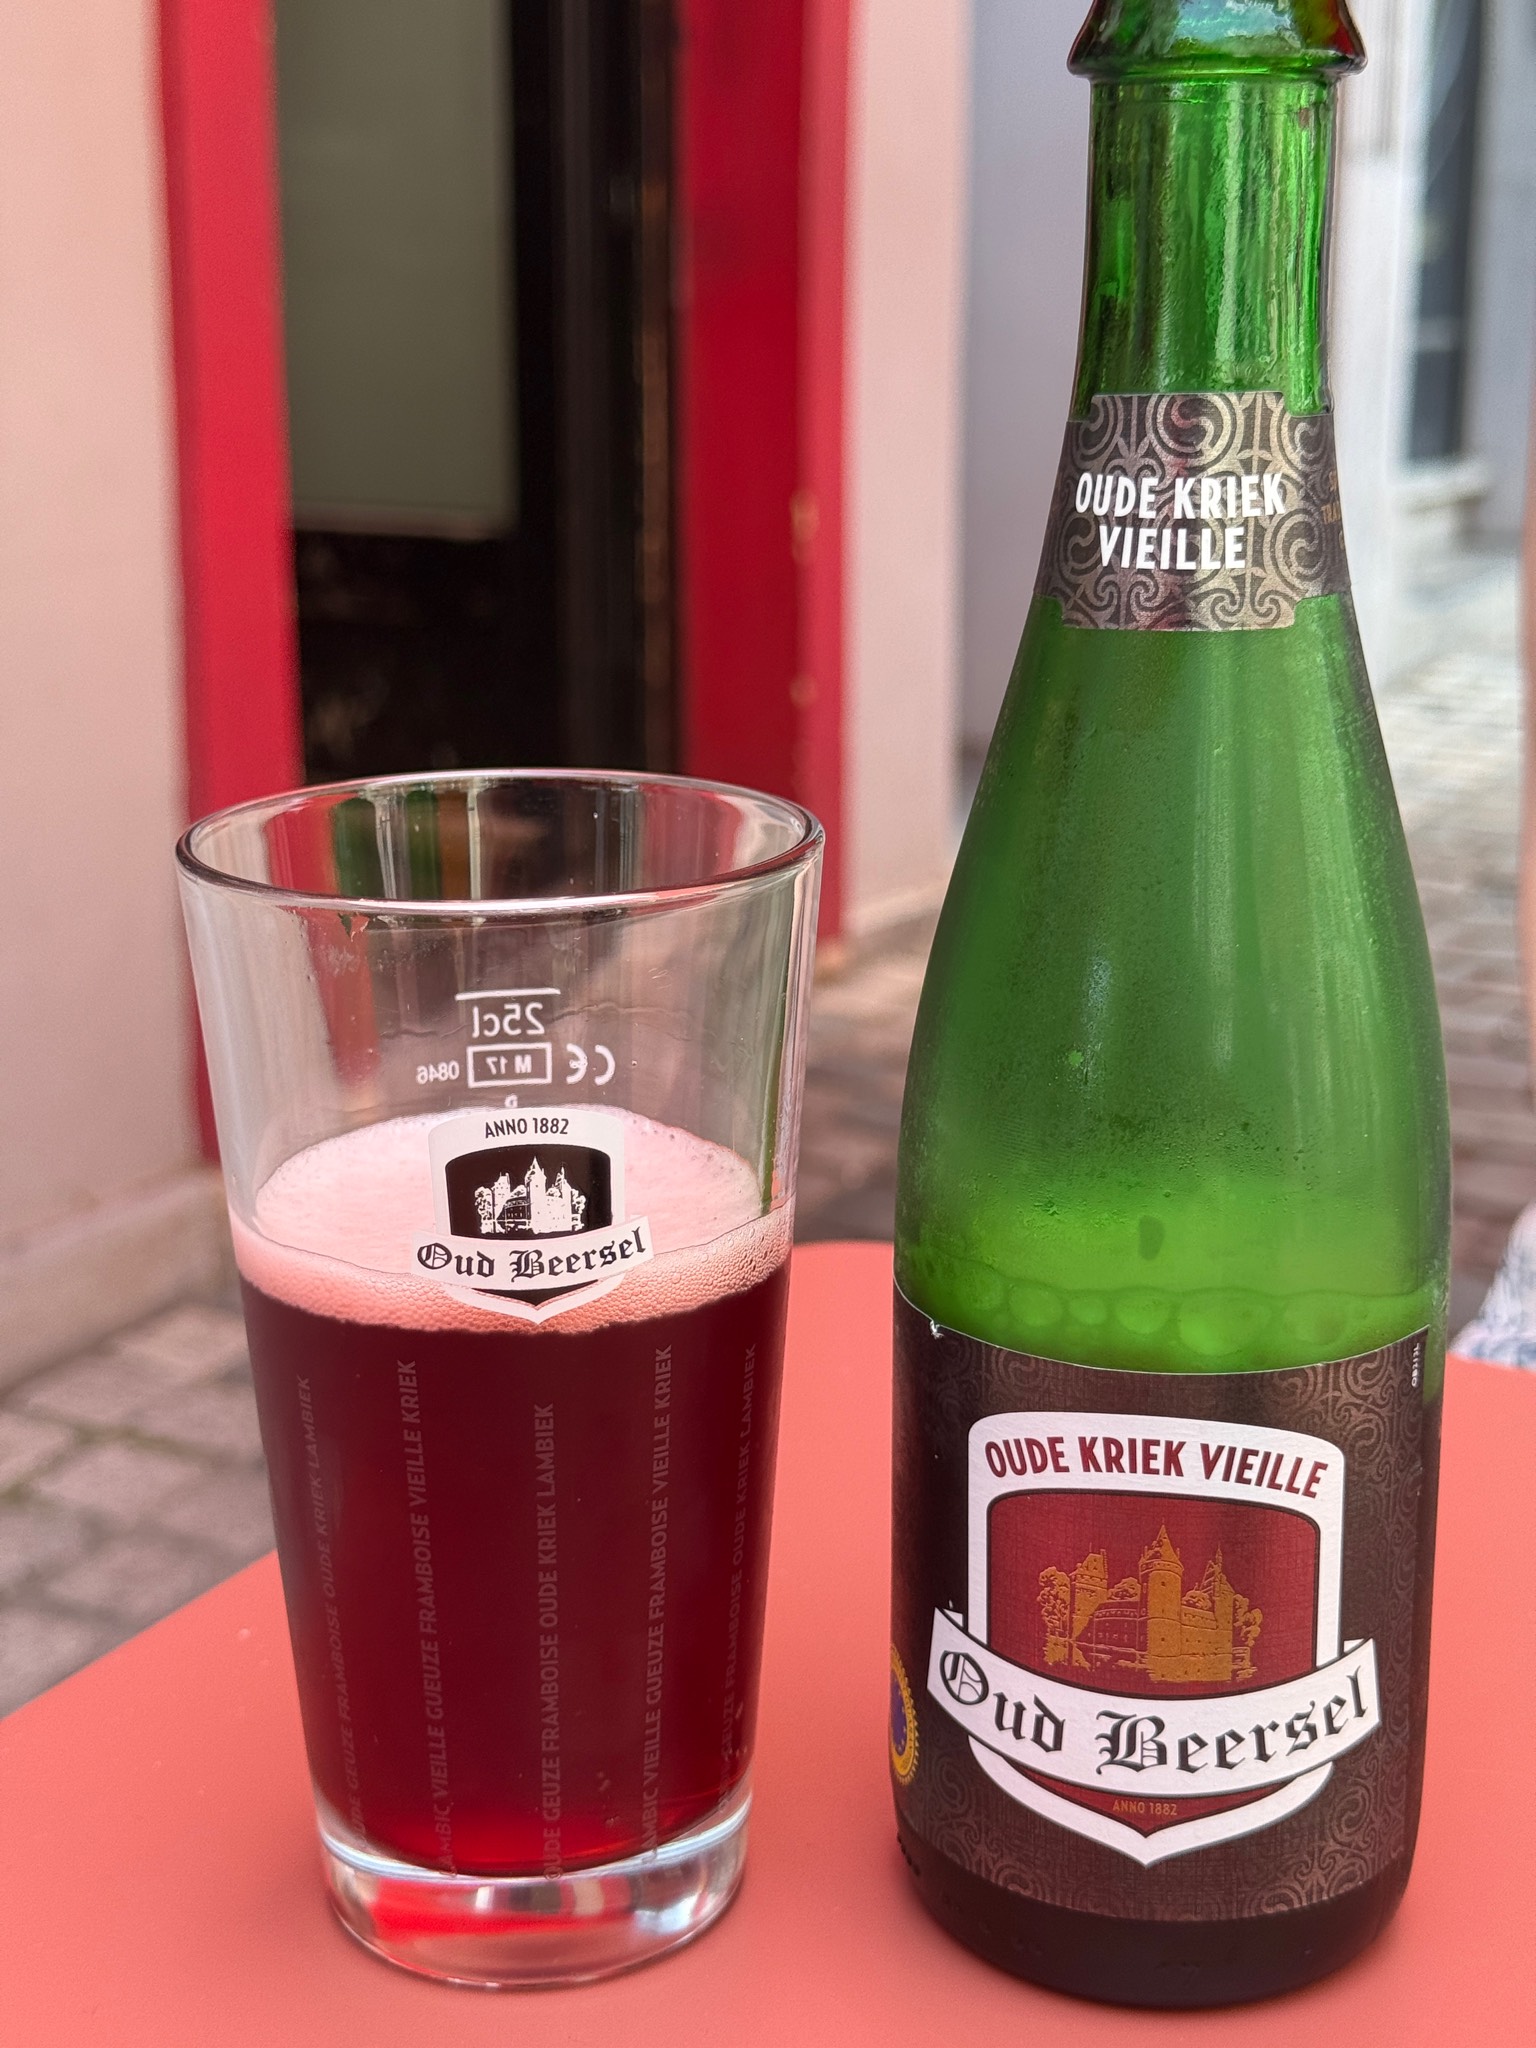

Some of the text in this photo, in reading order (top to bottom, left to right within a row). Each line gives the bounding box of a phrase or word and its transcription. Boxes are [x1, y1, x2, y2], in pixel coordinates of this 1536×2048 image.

[1075, 473, 1157, 519] OUDE
[1173, 472, 1286, 519] KRIEK
[1098, 526, 1246, 570] VIEILLE
[485, 1117, 570, 1139] ANNO 1882
[417, 1226, 646, 1282] Oud Beersel
[397, 1359, 421, 1424] KRIEK
[655, 1343, 673, 1410] KRIEK
[296, 1374, 320, 1469] LAMBIEK
[652, 1413, 671, 1495] VIEILLE
[403, 1429, 427, 1507] VIEILLE
[736, 1440, 751, 1504] KRIEK
[985, 1436, 1329, 1500] OUDE KRIEK VIEILLE
[308, 1477, 329, 1536] KRIEK
[732, 1507, 747, 1565] OUDE
[316, 1541, 337, 1598] OUDE
[410, 1512, 438, 1634] FRAMBOISE
[648, 1497, 670, 1619] FRAMBOISE
[325, 1602, 352, 1721] FRAMBOISE
[533, 1402, 562, 1881] OUDE GEUZE FRAMBOISE OUDE KRIEK LAMBIEK
[645, 1622, 665, 1705] GUEUZE
[421, 1639, 445, 1720] GUEUZE
[939, 1648, 1065, 1755] Oud
[1095, 1666, 1368, 1775] Beersel
[427, 1724, 450, 1800] VIEILLE
[643, 1708, 662, 1786] VIEILLE
[348, 1796, 367, 1841] UDE
[1112, 1799, 1179, 1817] ANNO 1882
